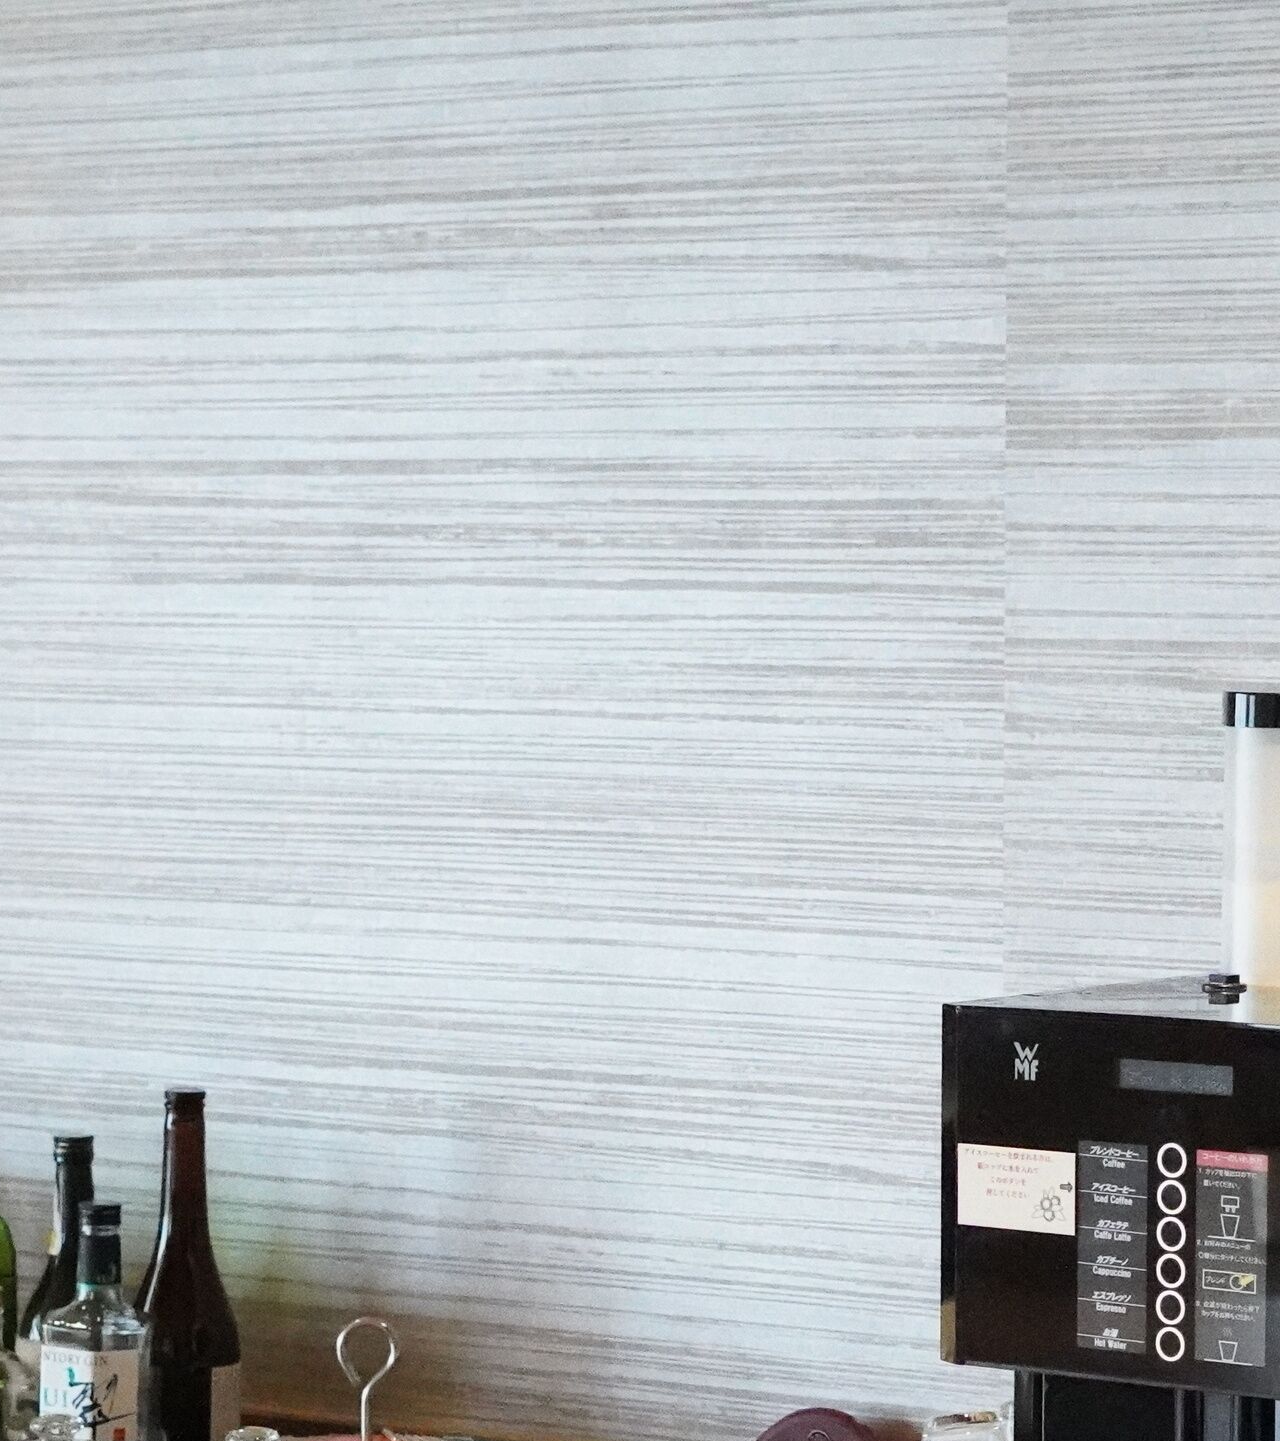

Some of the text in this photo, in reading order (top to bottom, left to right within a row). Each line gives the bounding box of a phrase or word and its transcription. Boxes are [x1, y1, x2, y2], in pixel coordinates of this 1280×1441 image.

[1089, 1145, 1140, 1158] ブレンドコーヒー
[1102, 1158, 1126, 1168] Coffee
[1091, 1182, 1137, 1194] アイスコーヒー
[1094, 1193, 1133, 1206] Iced Coffee
[1096, 1219, 1129, 1230] カフェラテ
[1113, 1232, 1132, 1242] Latte
[1095, 1254, 1129, 1266] カプチーノ
[1092, 1265, 1132, 1278] Cappuccino
[1091, 1290, 1132, 1303] エスプレッソ
[1096, 1302, 1127, 1314] Espresso
[1094, 1338, 1127, 1350] Hot Water
[43, 1351, 80, 1365] NTORY
[43, 1387, 68, 1408] UI
